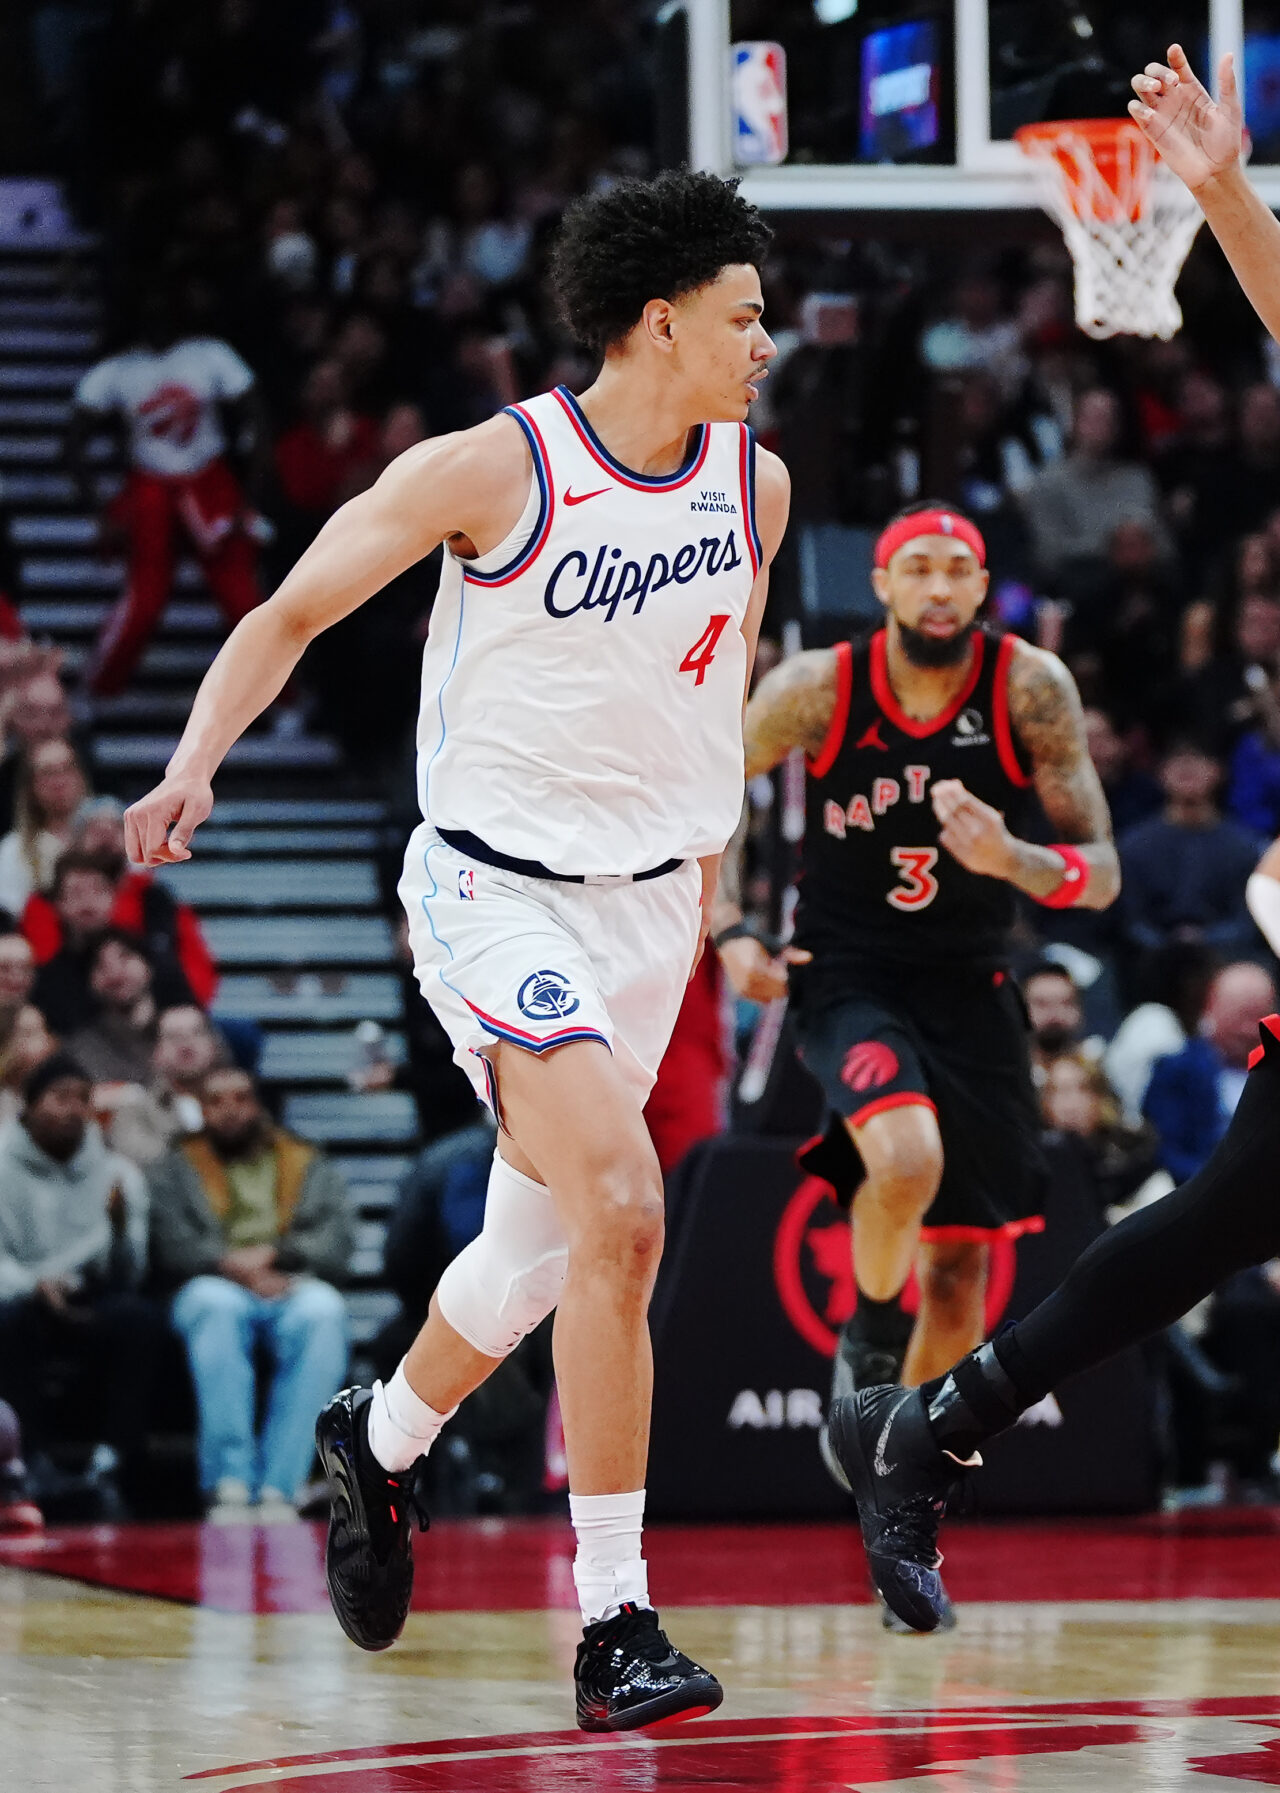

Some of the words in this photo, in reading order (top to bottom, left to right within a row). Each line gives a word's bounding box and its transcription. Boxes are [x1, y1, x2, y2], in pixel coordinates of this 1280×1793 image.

[690, 501, 737, 513] RWANDA
[700, 490, 726, 502] VISIT
[543, 528, 742, 623] Clippers
[678, 614, 732, 687] 4
[823, 764, 931, 840] RAPT
[885, 846, 939, 912] 3
[727, 1388, 824, 1430] AIR
